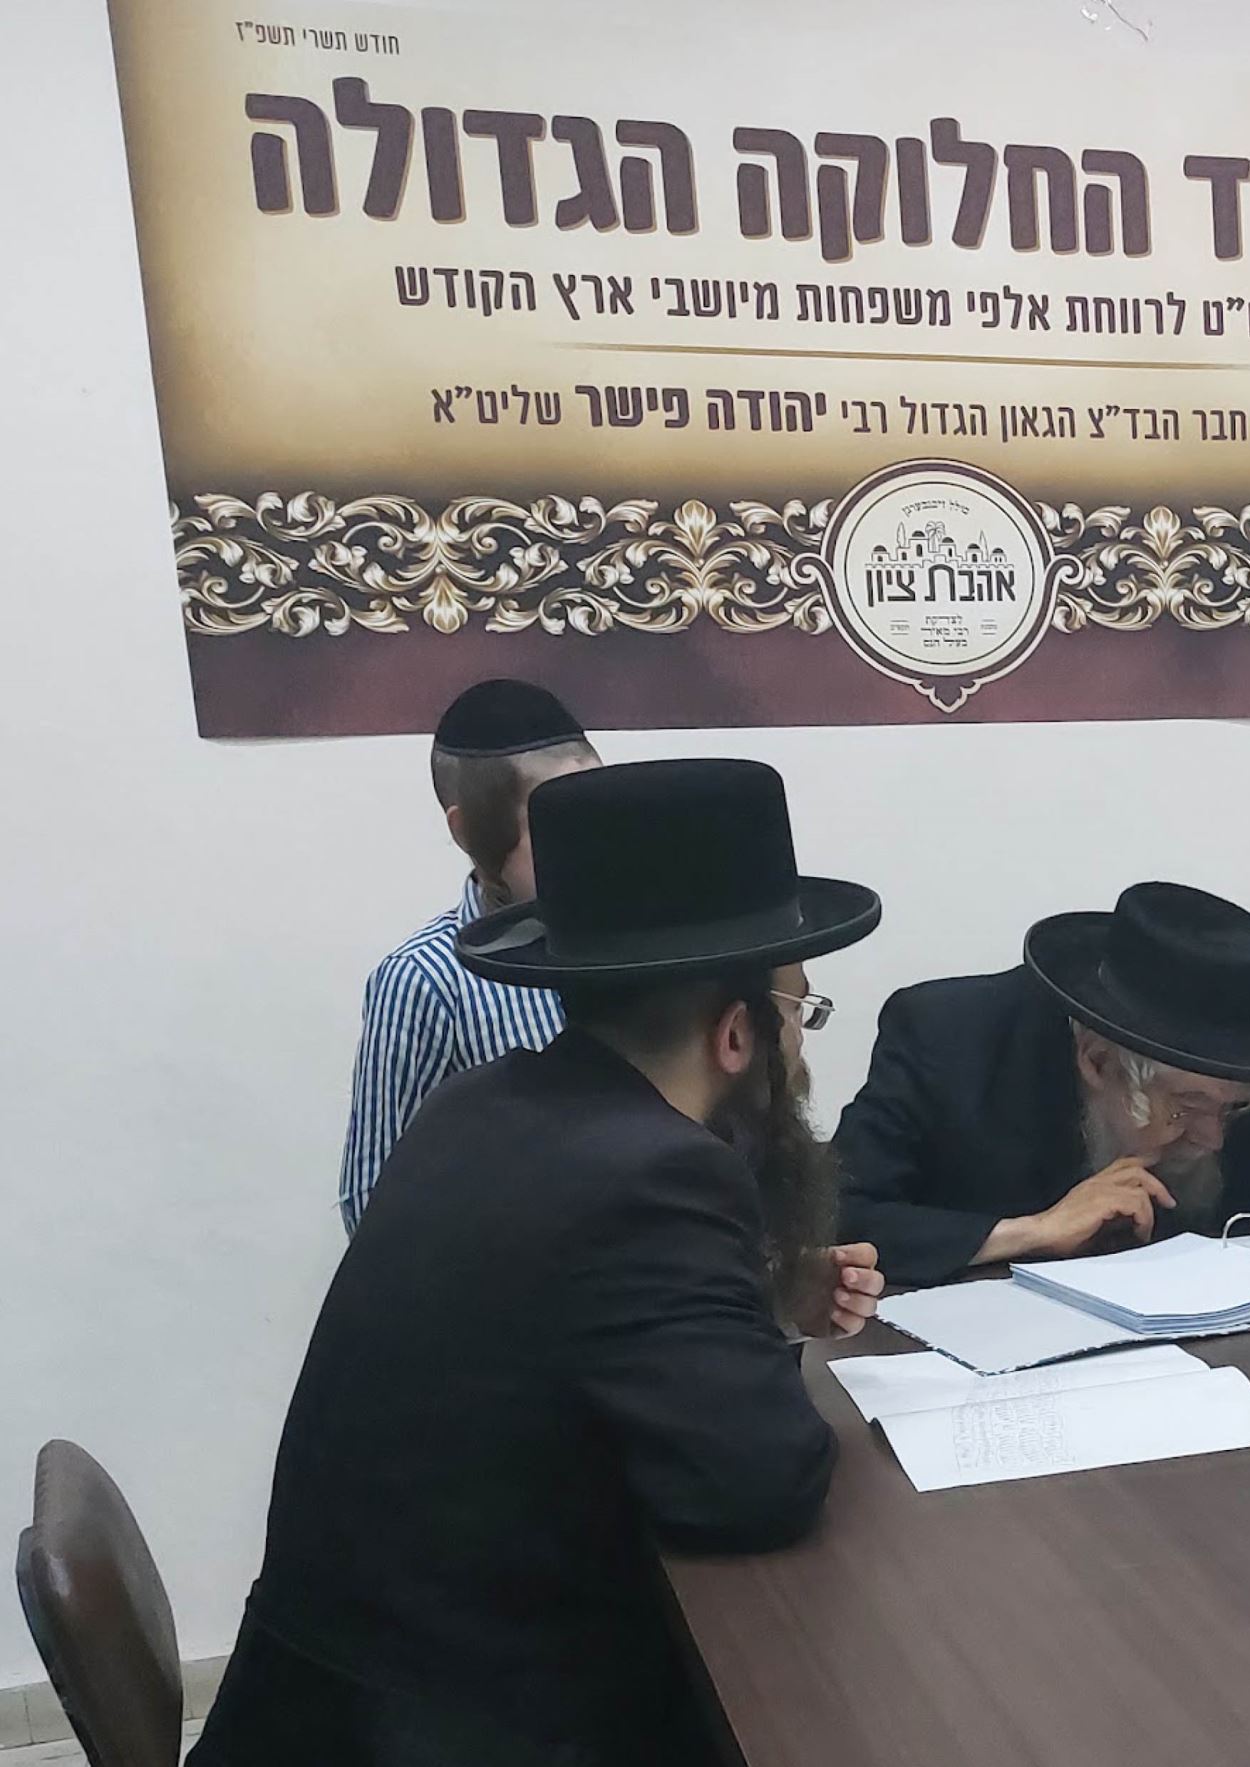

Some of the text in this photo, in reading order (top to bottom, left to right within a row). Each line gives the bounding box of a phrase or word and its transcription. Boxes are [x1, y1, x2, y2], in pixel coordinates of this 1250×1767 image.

[235, 20, 400, 55] חודש תשרי תשפ"ז
[245, 76, 700, 236] הגדולה
[733, 117, 1152, 264] החלוקה
[395, 266, 537, 317] הקודש
[552, 272, 635, 321] ארץ
[651, 277, 780, 322] מיושבי
[796, 283, 952, 329] משפחות
[967, 285, 1052, 331] אלפי
[1066, 291, 1187, 336] לרווחת
[431, 384, 562, 426] שליט"א
[574, 384, 691, 428] פישר
[706, 389, 827, 432] יהודה
[841, 400, 888, 435] רבי
[900, 396, 988, 437] הגדול
[1000, 404, 1077, 444] הגאון
[1088, 405, 1180, 441] הבד"צ
[1192, 410, 1248, 442] חבר
[865, 563, 1016, 607] אהבת ציון
